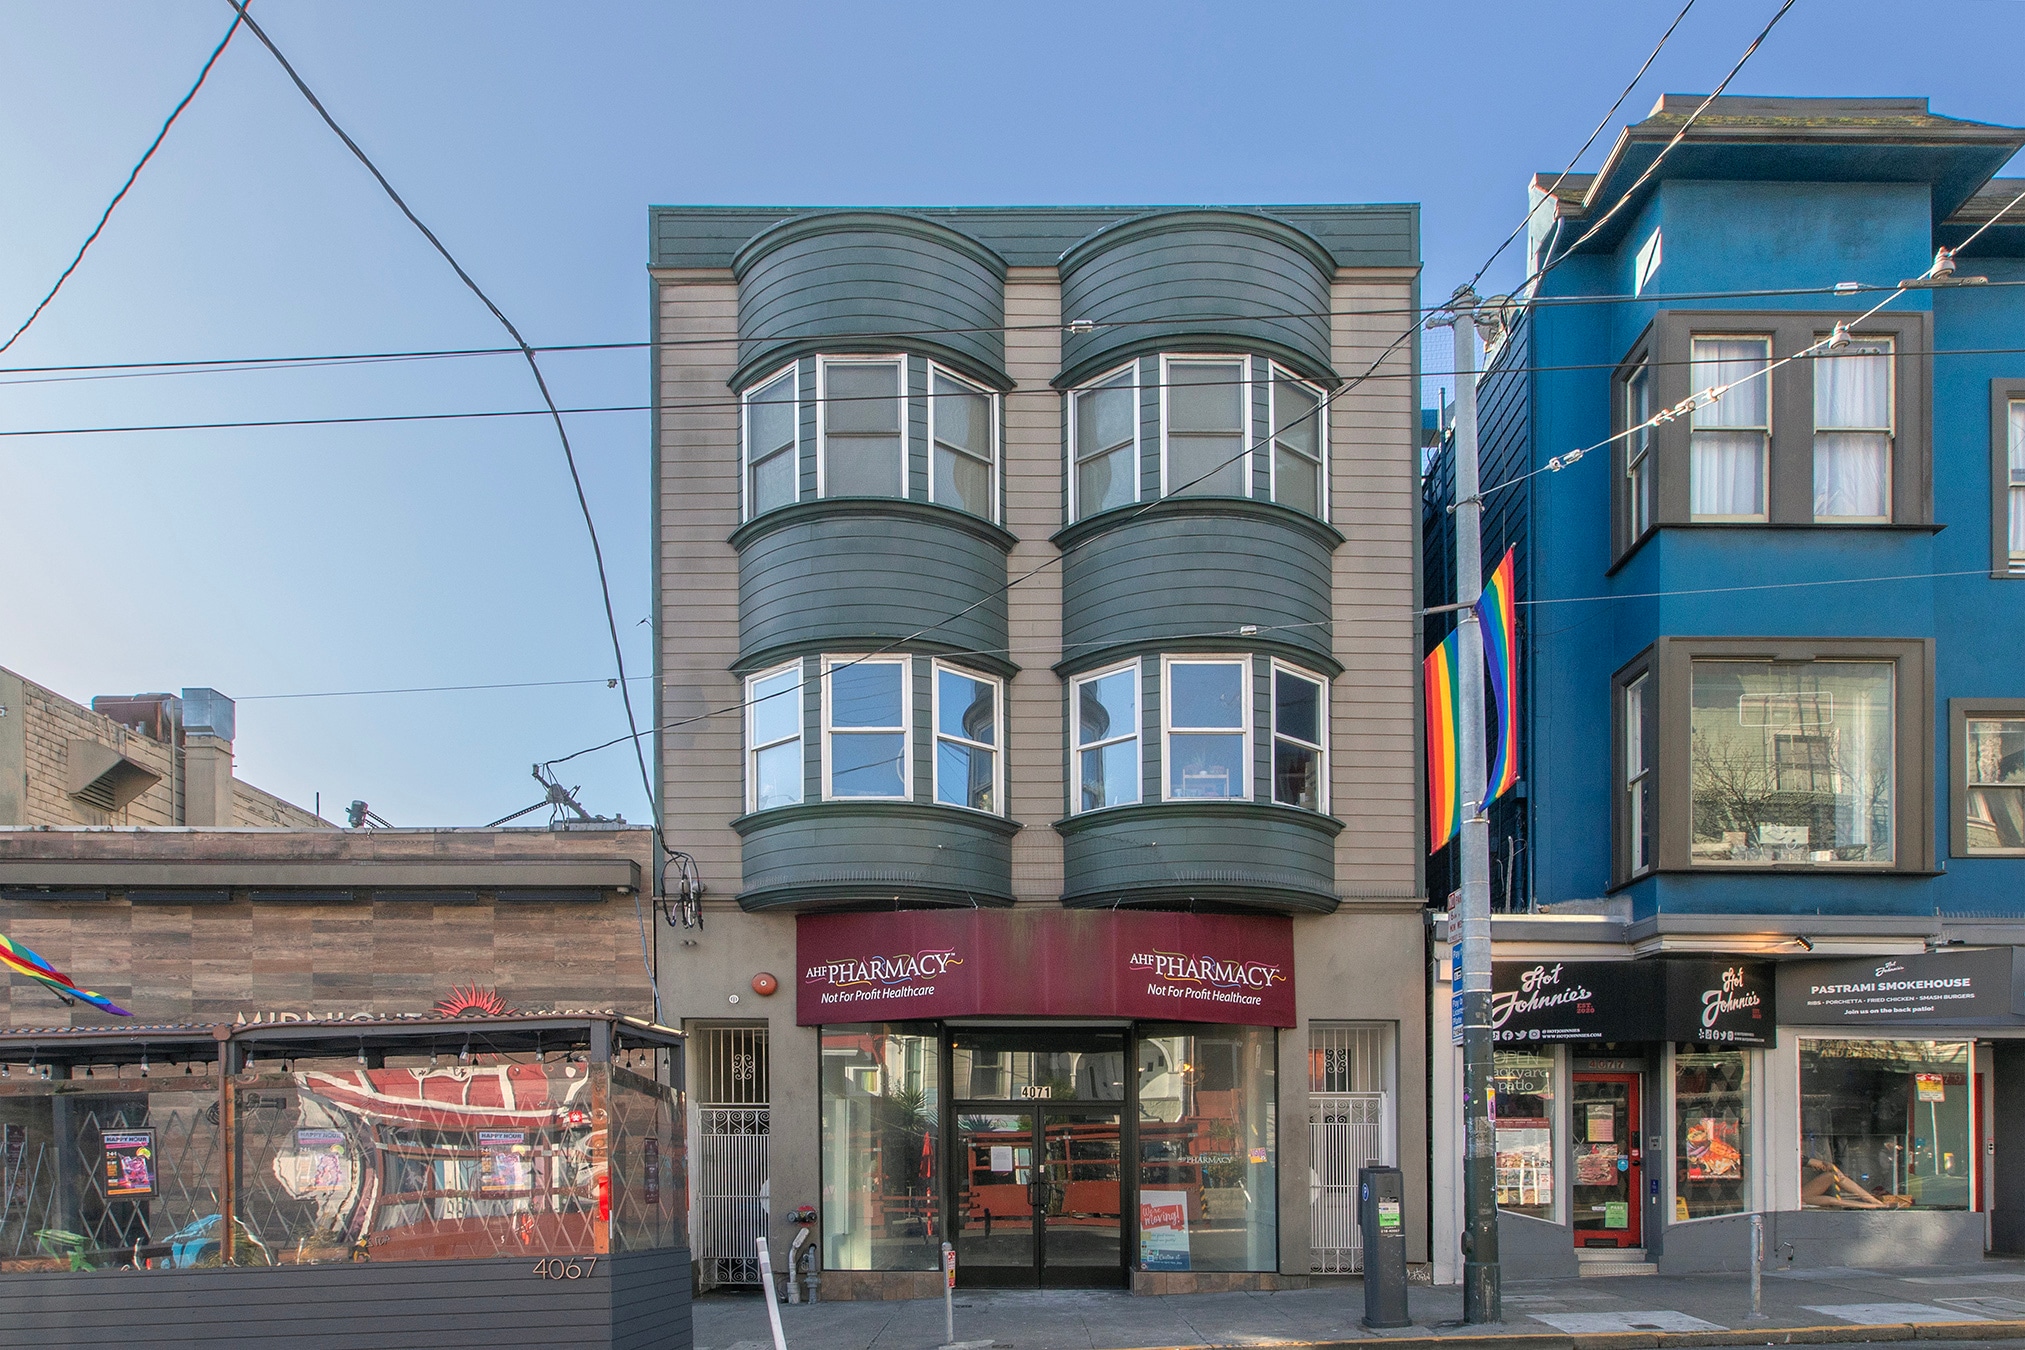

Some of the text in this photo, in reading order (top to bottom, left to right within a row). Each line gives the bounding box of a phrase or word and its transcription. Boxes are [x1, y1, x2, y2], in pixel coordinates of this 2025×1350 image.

[806, 953, 951, 984] AHF PHARMACY
[1130, 953, 1276, 987] AHF PHARMACY
[1521, 963, 1564, 992] Hot
[1722, 967, 1744, 992] Hot
[821, 986, 935, 1004] Not For Profit Healthcare
[1148, 984, 1262, 1006] Not For Profit Healthcare
[1811, 978, 1971, 994] PASTRAMI SMOKEHOUSE
[1492, 985, 1592, 1030] Johnnie's
[1702, 990, 1760, 1028] Johnnie's
[1493, 1050, 1539, 1065] OPEN
[1022, 1086, 1050, 1098] 4071
[1498, 1080, 1534, 1093] patio
[1186, 1156, 1232, 1164] PHARMACY
[532, 1256, 597, 1280] 4067
